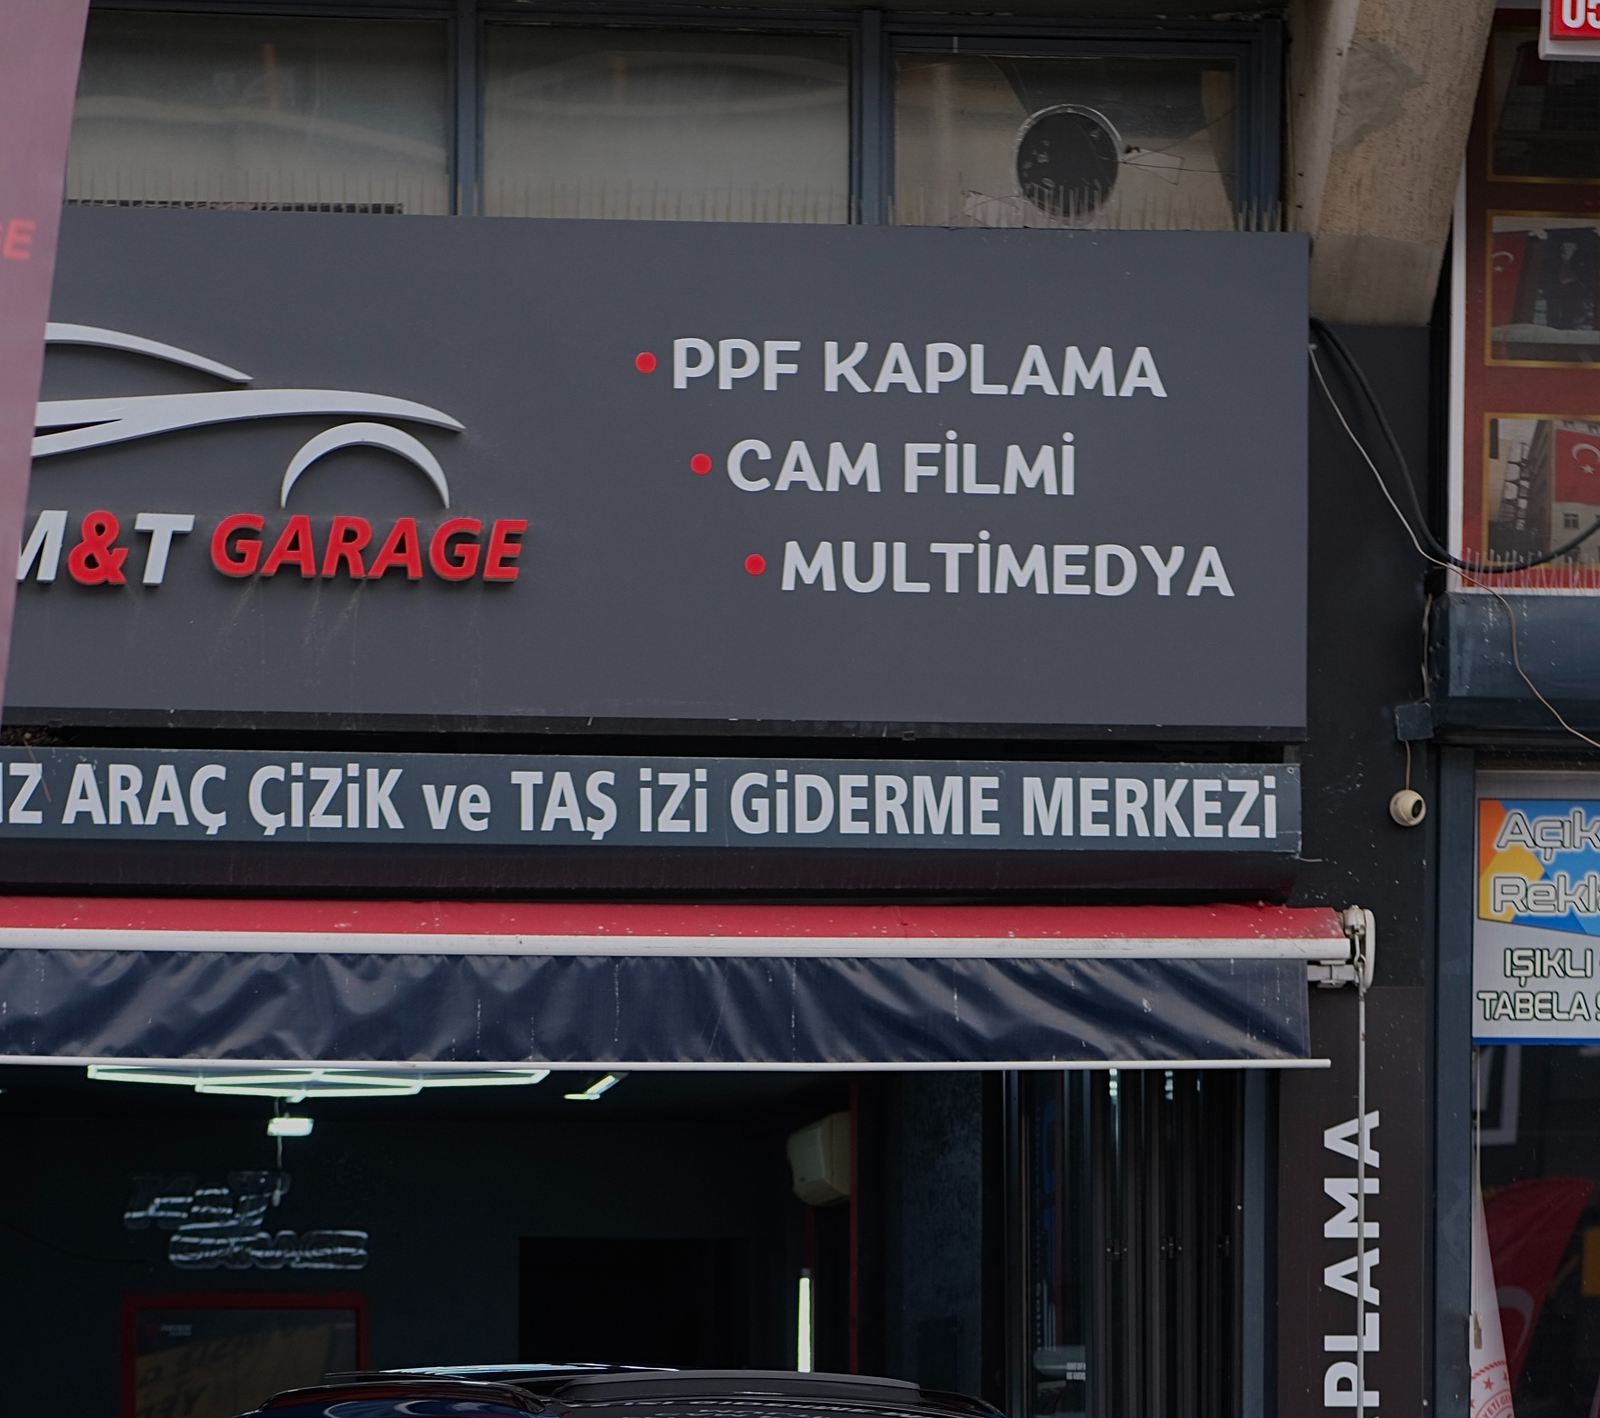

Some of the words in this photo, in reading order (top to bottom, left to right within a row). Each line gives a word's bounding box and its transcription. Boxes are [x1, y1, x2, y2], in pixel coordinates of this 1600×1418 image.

[0, 218, 36, 260] E
[674, 338, 800, 390] PPF
[825, 342, 1167, 397] KAPLAMA
[728, 440, 880, 492] CAM
[905, 431, 1074, 495] FİLMİ
[16, 510, 195, 585] M&T
[211, 513, 528, 580] GARAGE
[782, 530, 1234, 597] MULTİMEDYA
[0, 763, 43, 823] Z
[62, 764, 227, 834] ARAÇ
[423, 785, 490, 831] ve
[511, 771, 616, 840] TAŞ
[1493, 874, 1600, 913] Rekl
[1503, 948, 1593, 987] IŞIKLI
[1478, 991, 1590, 1021] TABELA
